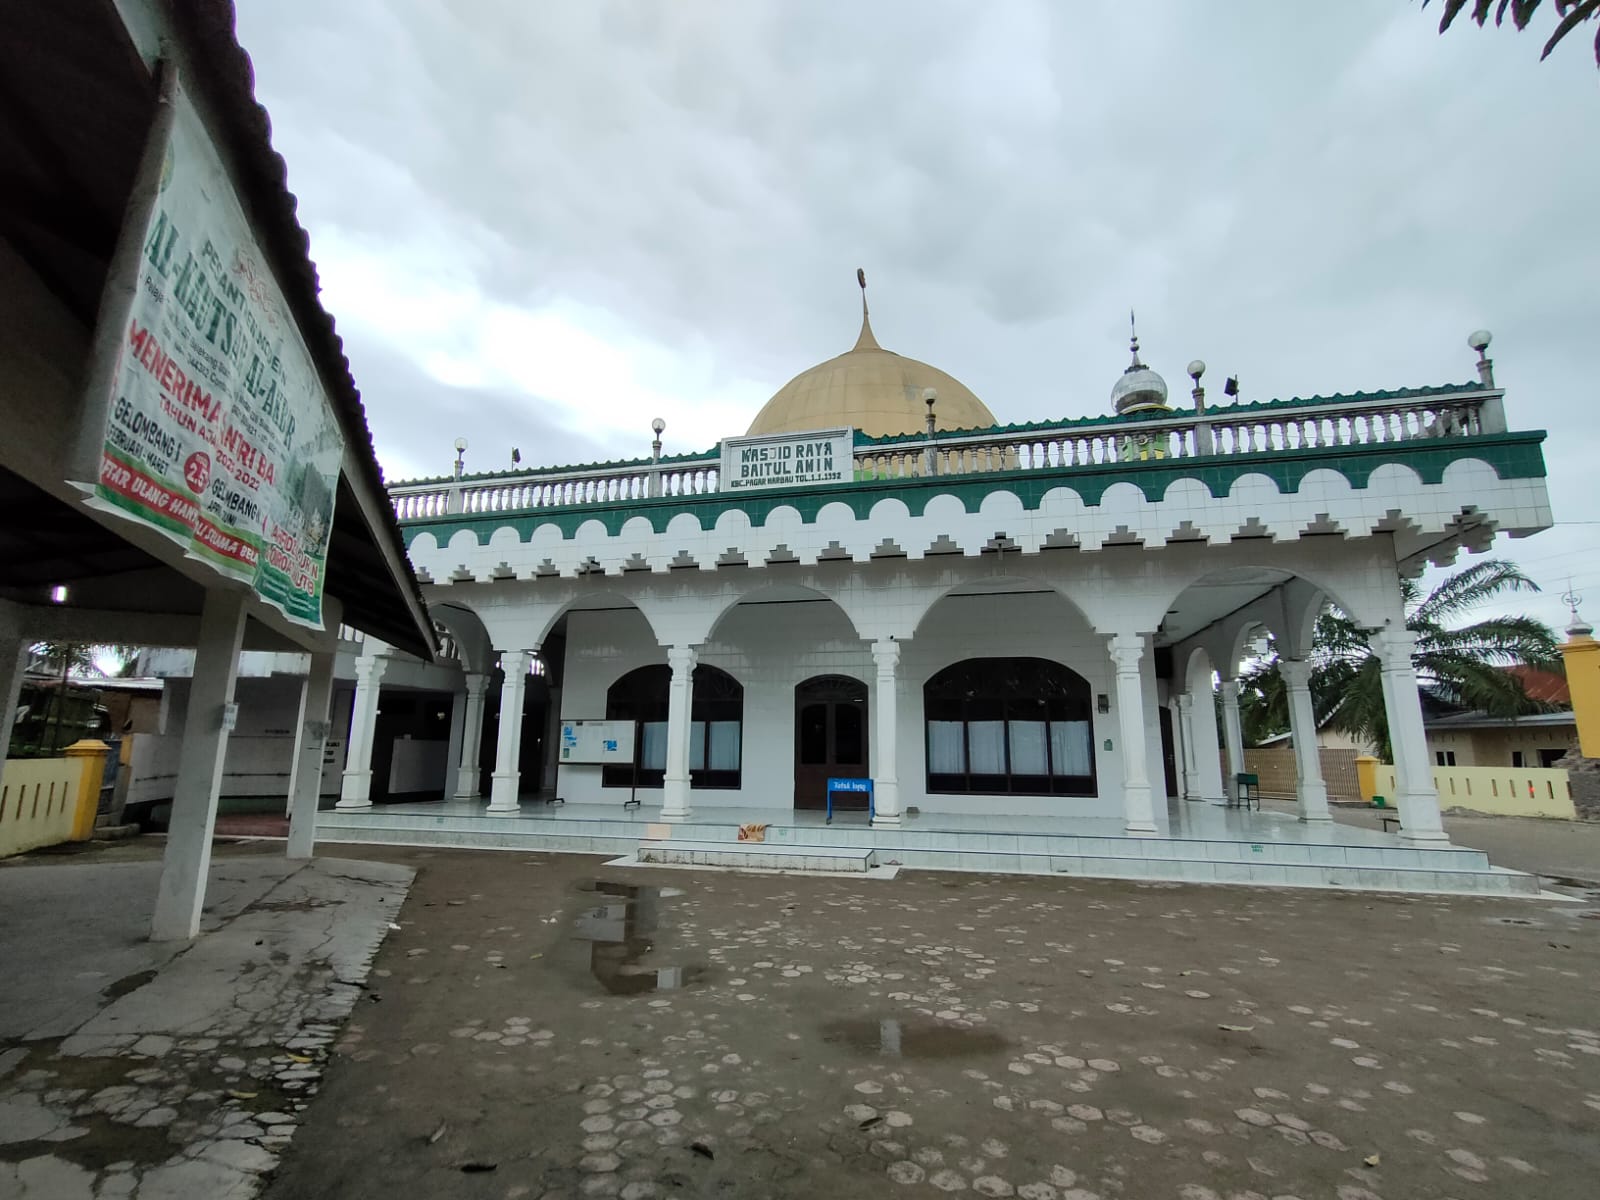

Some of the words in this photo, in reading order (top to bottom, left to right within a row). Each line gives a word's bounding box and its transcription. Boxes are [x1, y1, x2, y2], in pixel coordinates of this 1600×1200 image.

[202, 239, 257, 340] PESANTEN
[130, 318, 221, 424] MENERIMA
[160, 393, 196, 433] TAHUN
[243, 354, 295, 450] AL-AKBR
[114, 398, 175, 457] GELOMBANG
[741, 463, 791, 478] BAITUL
[796, 458, 832, 474] AMIN
[796, 442, 832, 458] RAYA
[132, 478, 168, 506] ULANG
[212, 478, 257, 519] GELMBANG
